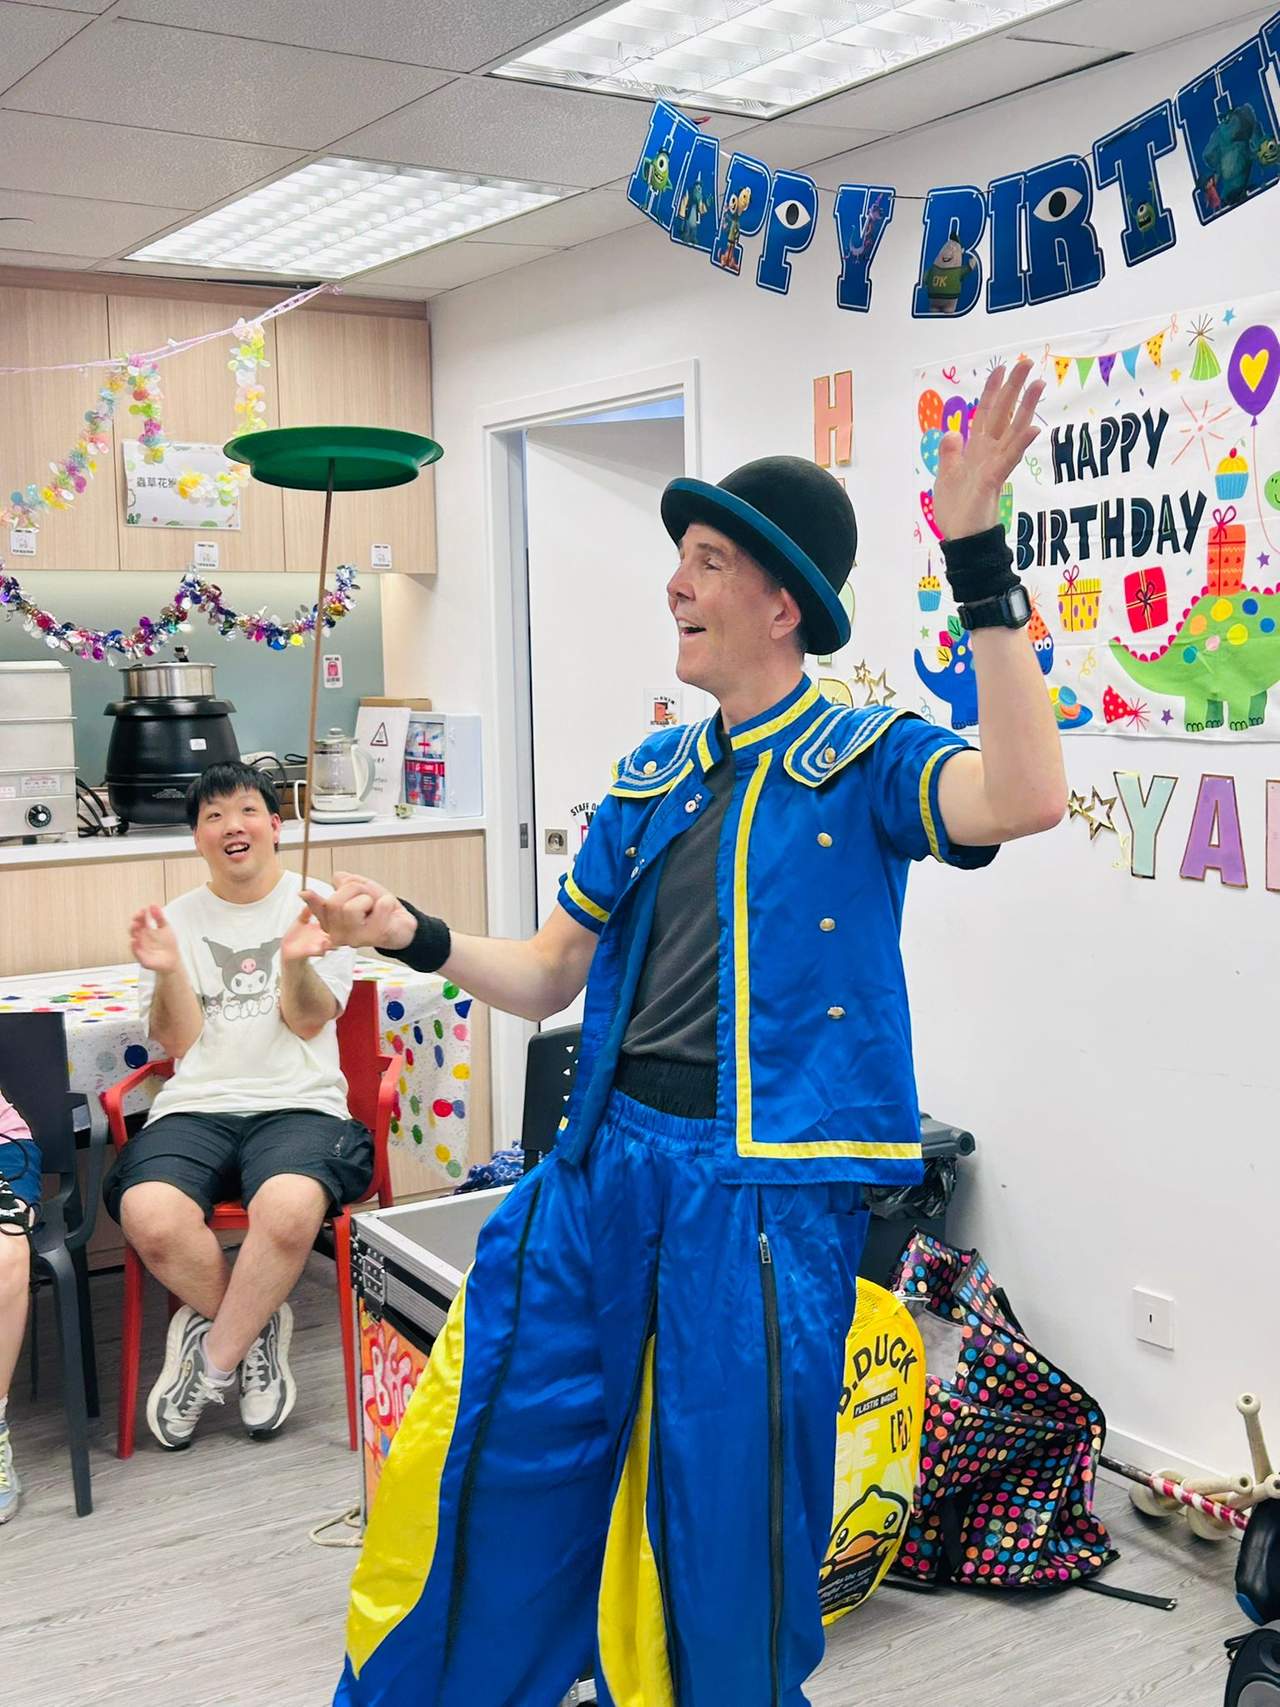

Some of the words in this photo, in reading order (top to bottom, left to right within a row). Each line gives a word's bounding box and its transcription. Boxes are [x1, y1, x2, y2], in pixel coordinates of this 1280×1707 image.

[627, 99, 896, 312] HAPPY
[932, 275, 948, 287] OK
[1051, 408, 1169, 484] HAPPY
[1016, 490, 1207, 570] BIRTHDAY
[570, 802, 589, 816] STAFF
[855, 1398, 879, 1416] PLASTIC
